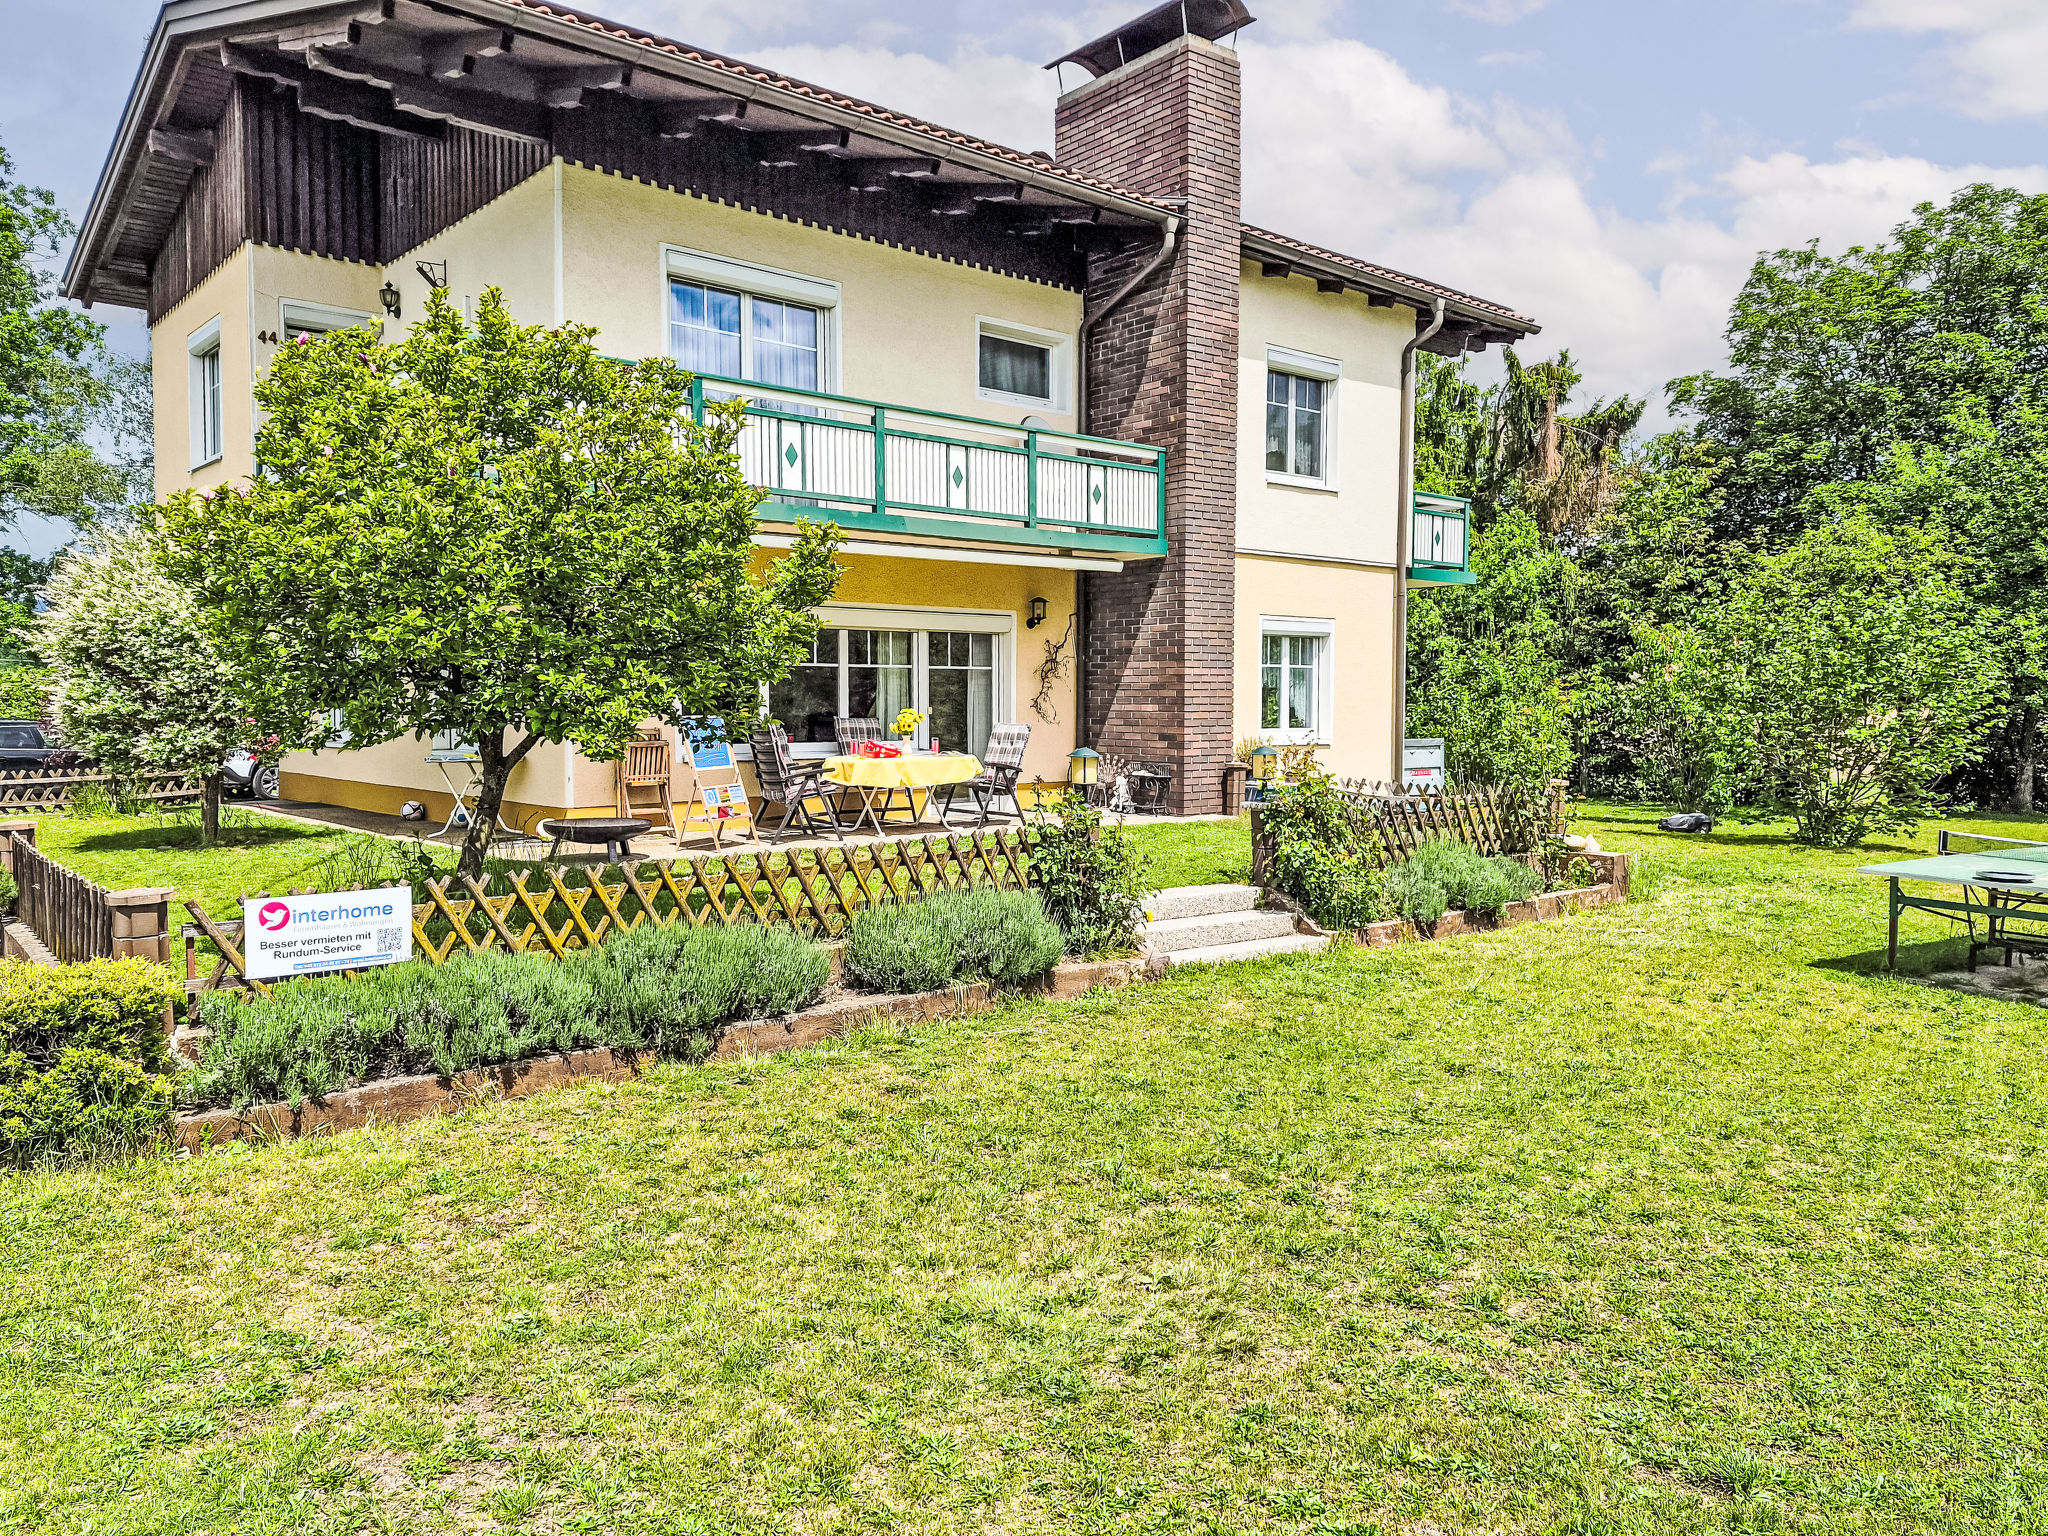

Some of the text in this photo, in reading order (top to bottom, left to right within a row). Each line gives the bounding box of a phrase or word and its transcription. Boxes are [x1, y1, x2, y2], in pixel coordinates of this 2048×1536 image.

[257, 330, 278, 345] 44
[292, 904, 393, 924] interhome
[349, 918, 394, 928] Wohnungen
[260, 932, 371, 950] Besser vermieten mit
[273, 943, 362, 959] Rundum-Service
